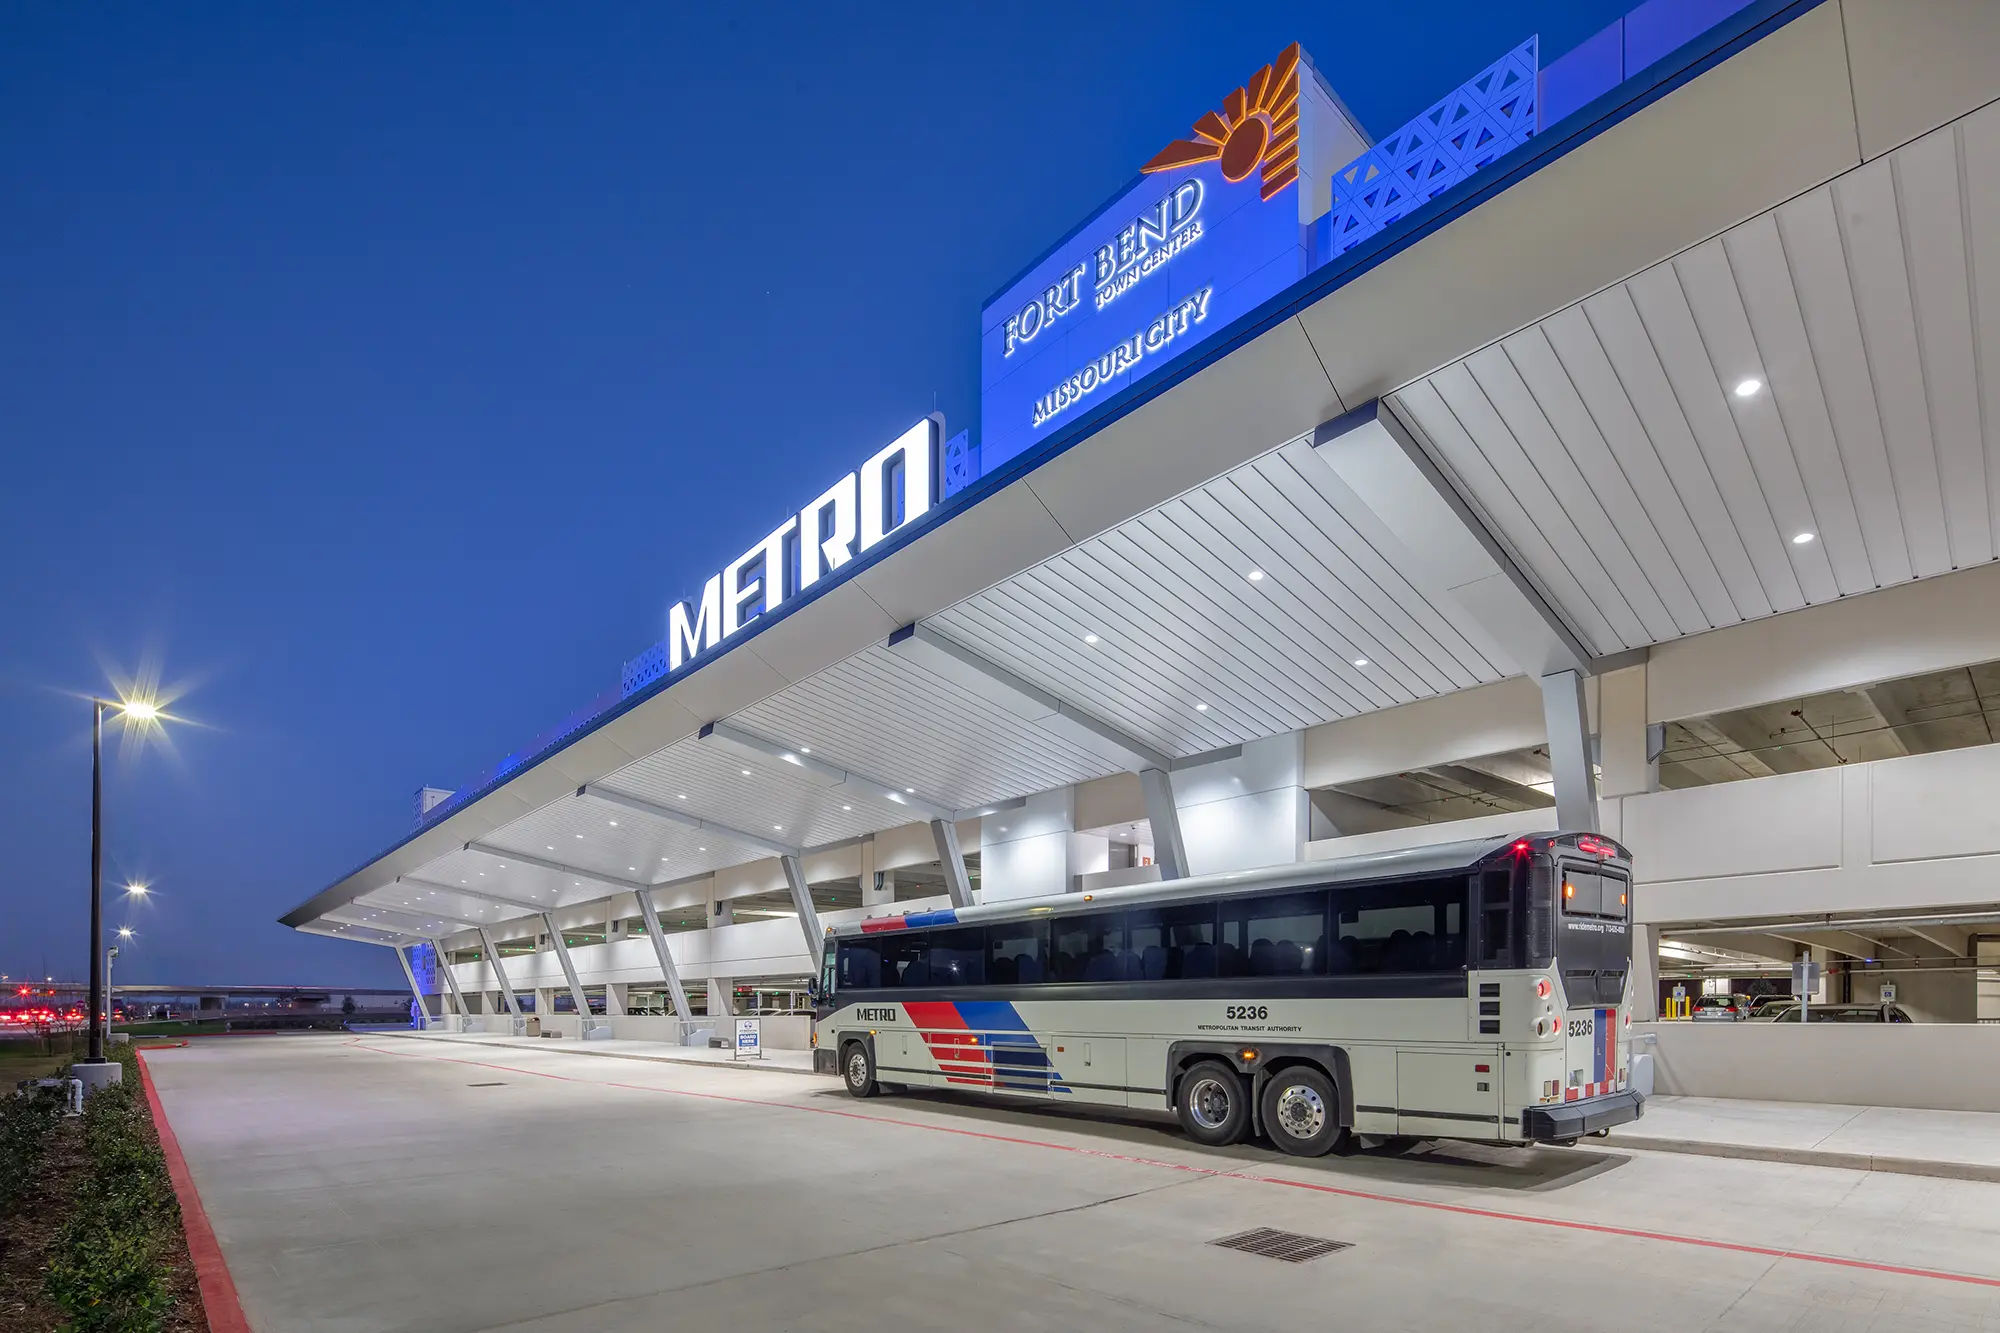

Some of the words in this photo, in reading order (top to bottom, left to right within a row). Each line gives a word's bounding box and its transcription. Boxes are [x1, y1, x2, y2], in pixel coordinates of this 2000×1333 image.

[1002, 263, 1086, 358] FORT
[1093, 179, 1204, 288] BEND
[1094, 266, 1140, 308] TOWN
[1140, 222, 1203, 273] CENTER
[1031, 335, 1142, 427] MISSOURI
[1144, 287, 1212, 352] CITY
[668, 416, 932, 672] METRO
[857, 1008, 896, 1021] METRO
[1226, 1006, 1268, 1020] 5236
[1568, 1019, 1593, 1037] 5236
